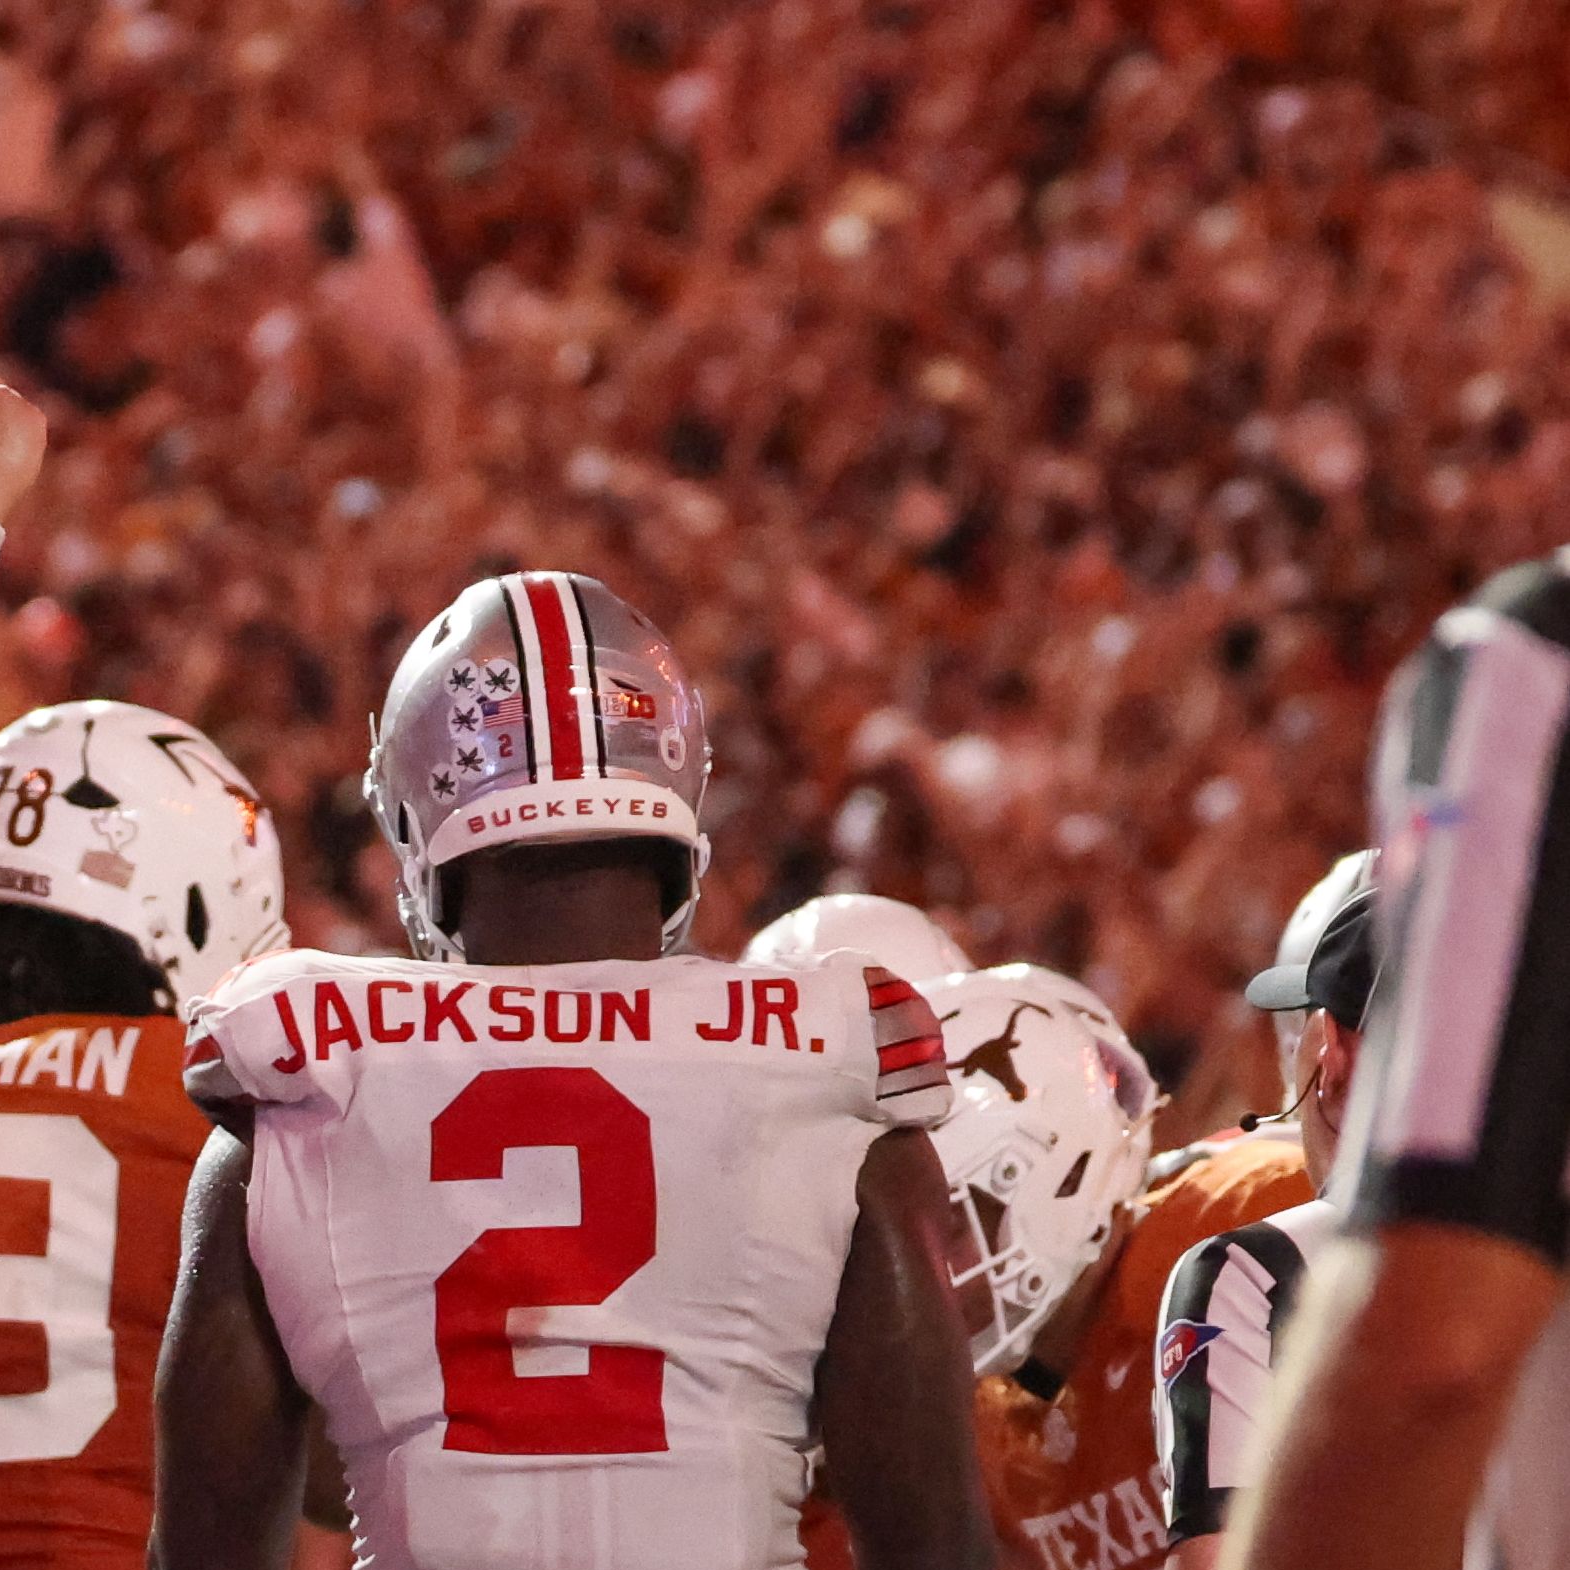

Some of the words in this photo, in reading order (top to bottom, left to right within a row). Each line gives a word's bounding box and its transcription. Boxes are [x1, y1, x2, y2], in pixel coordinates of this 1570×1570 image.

[498, 733, 513, 758] 2
[467, 798, 668, 834] BUCKEYES
[271, 980, 651, 1074] JACKSON
[696, 977, 825, 1054] JR.
[430, 1066, 670, 1456] 2
